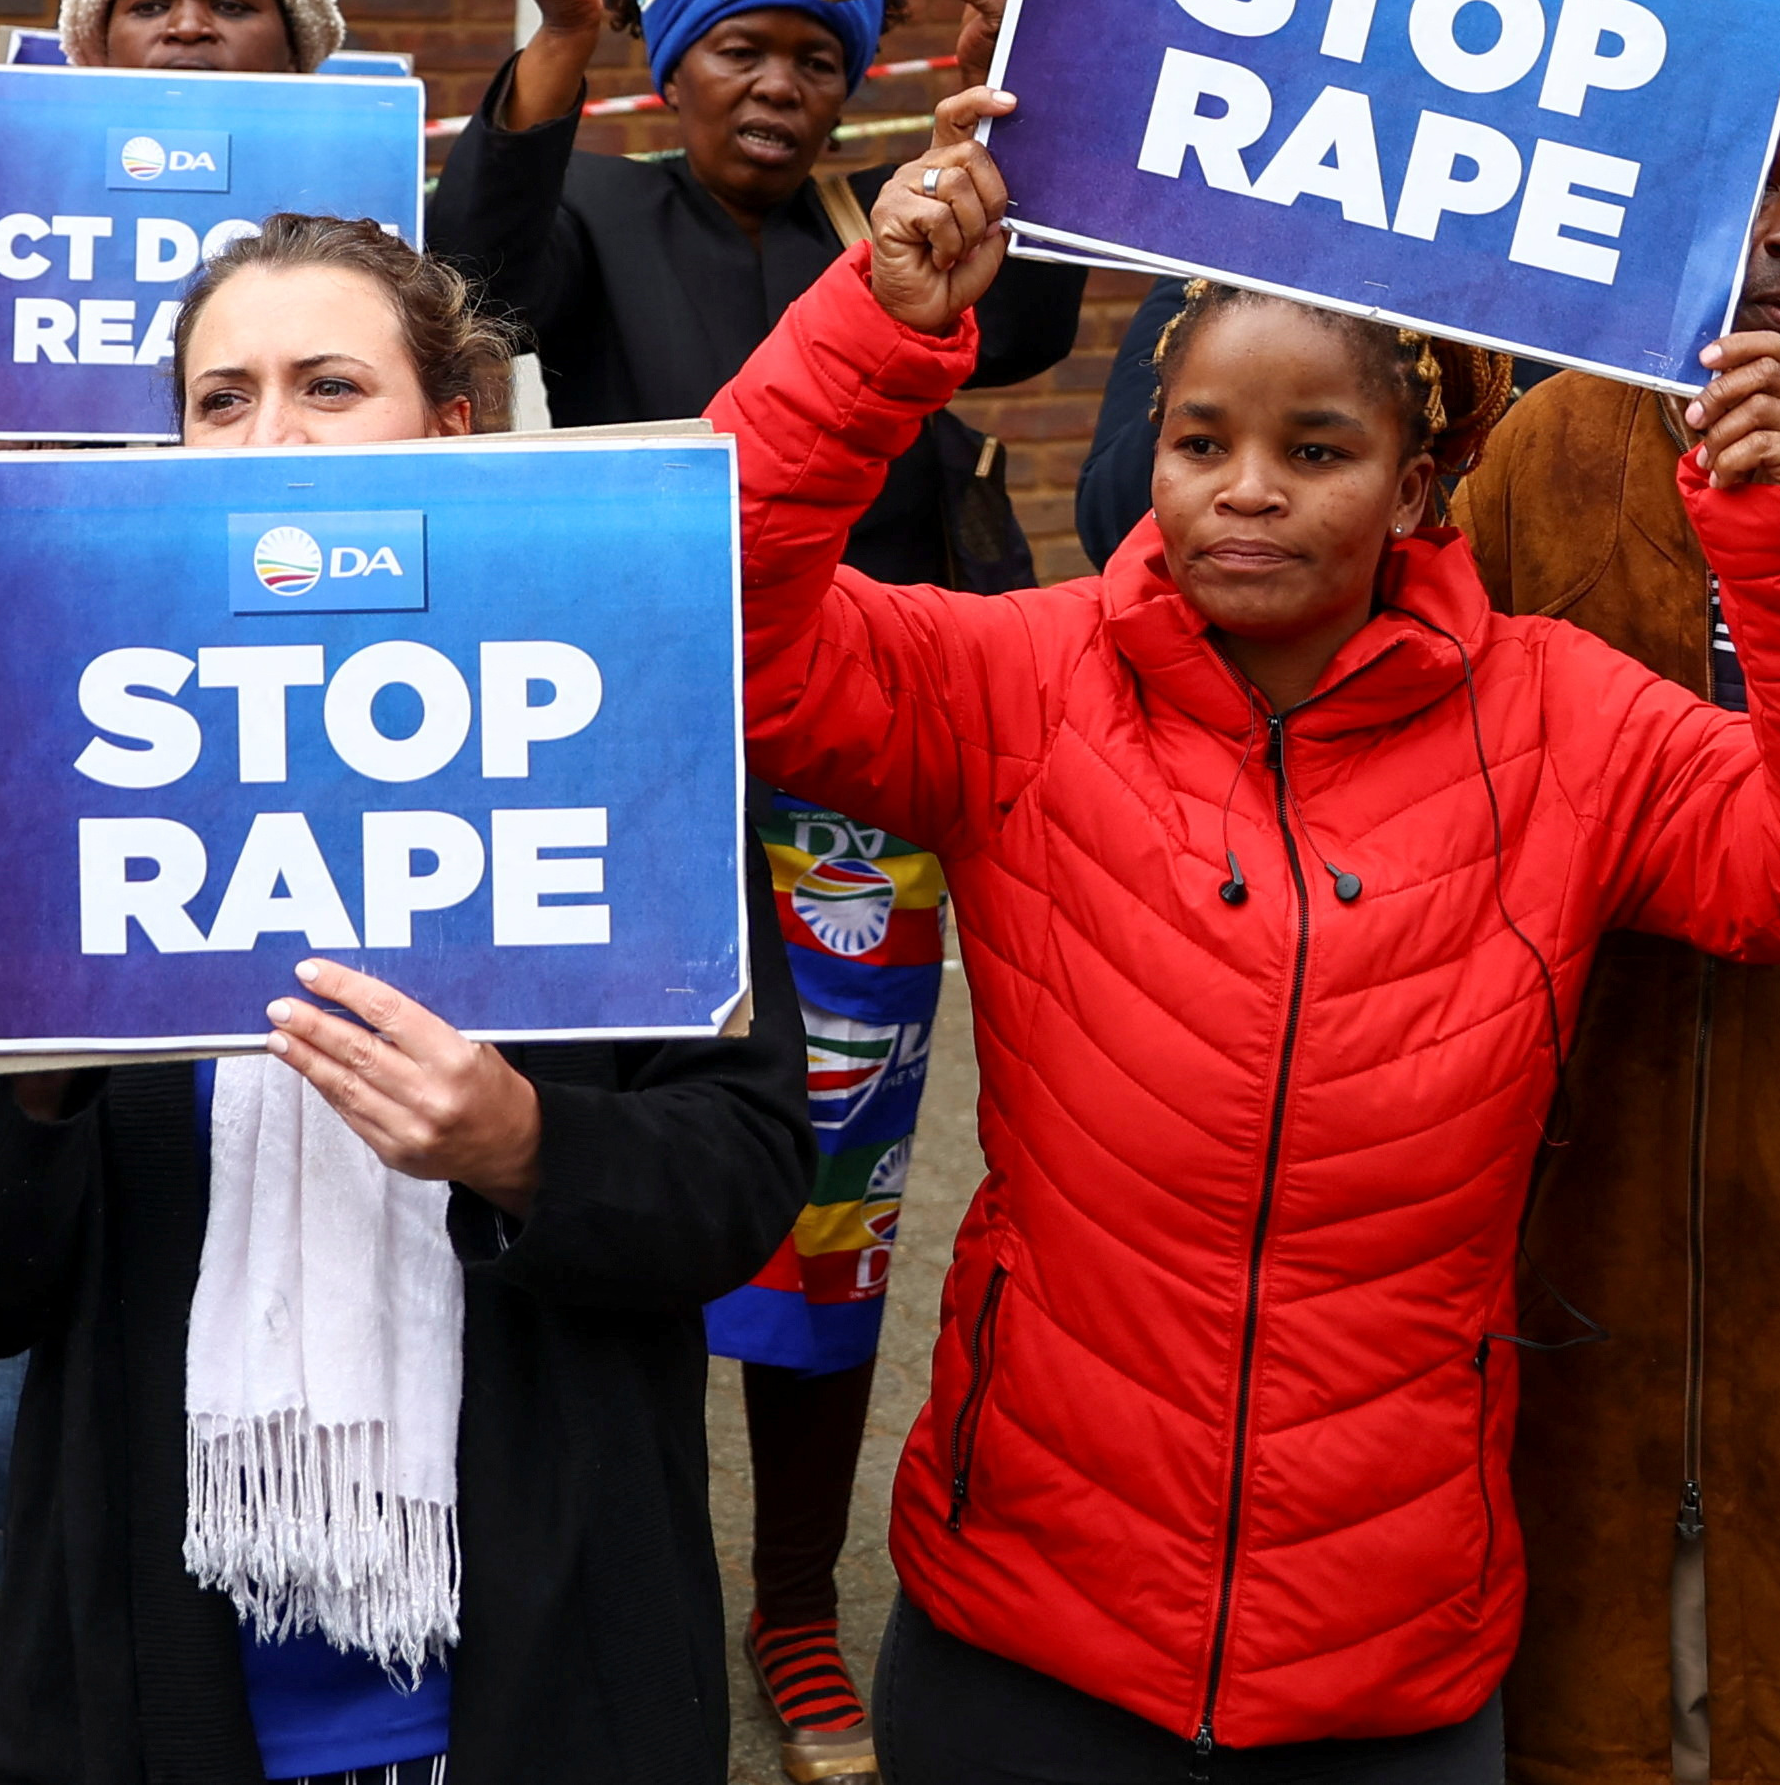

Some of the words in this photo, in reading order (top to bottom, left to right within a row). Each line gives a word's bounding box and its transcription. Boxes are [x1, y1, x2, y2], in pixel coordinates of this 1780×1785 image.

[168, 150, 217, 173] DA
[1136, 46, 1642, 286] RAPE
[12, 297, 181, 365] REA
[330, 546, 404, 578] DA
[73, 640, 603, 790] STOP
[78, 806, 612, 956] RAPE
